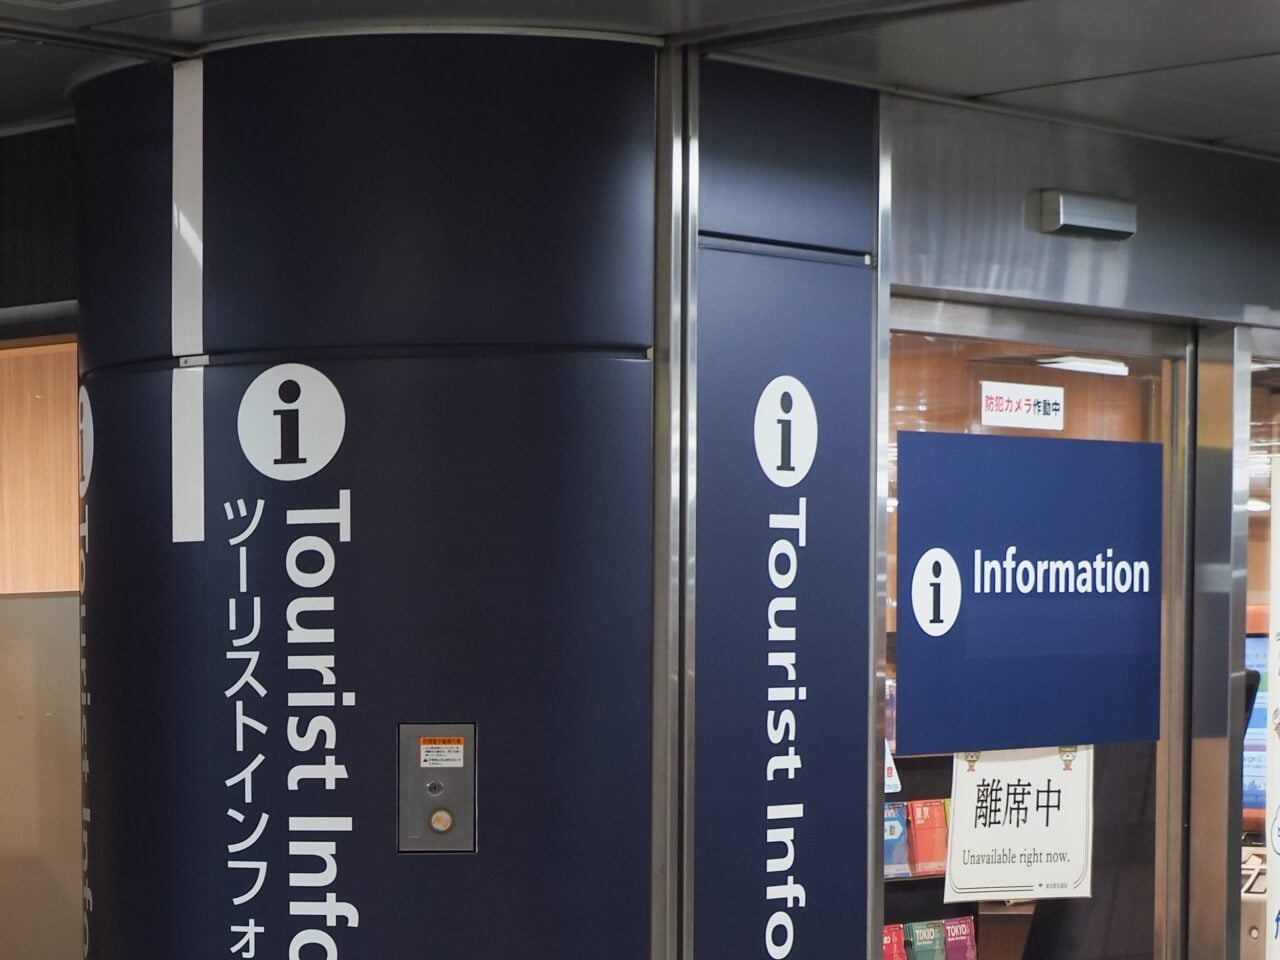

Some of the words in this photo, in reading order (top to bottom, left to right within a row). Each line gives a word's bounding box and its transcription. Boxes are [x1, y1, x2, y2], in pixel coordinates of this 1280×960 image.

[985, 395, 1060, 417] 防犯カメラ作動中
[974, 546, 1150, 593] Information
[286, 489, 356, 790] Tourist
[766, 497, 807, 781] Tourist
[974, 778, 1062, 829] 離席中
[962, 848, 1017, 866] Unavailable
[1019, 847, 1043, 868] right
[1046, 851, 1071, 863] now.
